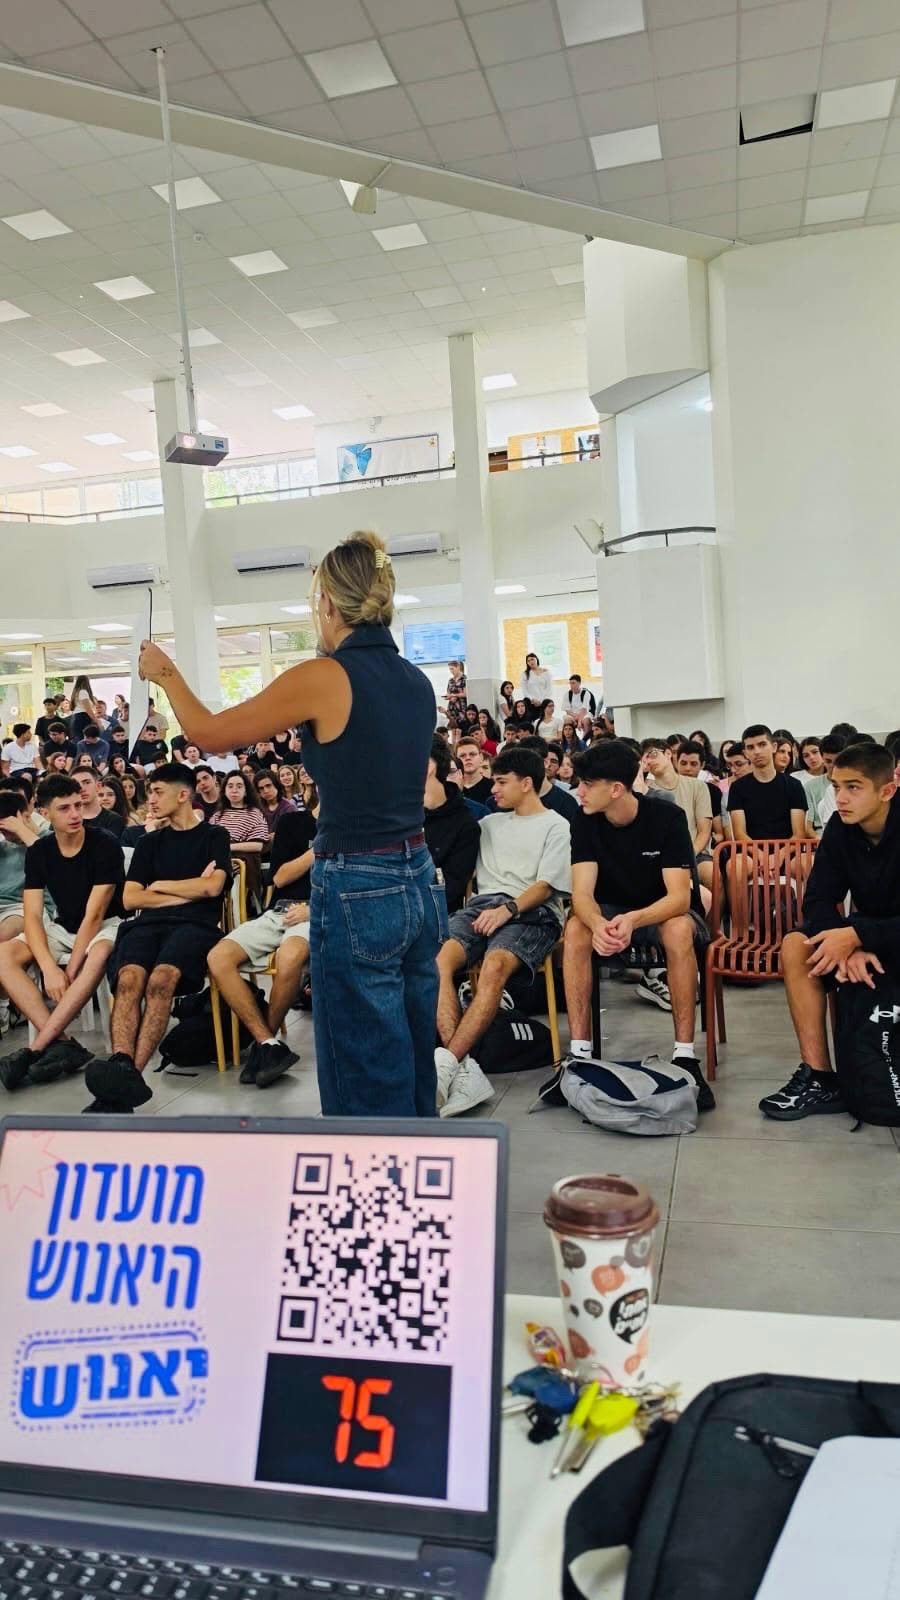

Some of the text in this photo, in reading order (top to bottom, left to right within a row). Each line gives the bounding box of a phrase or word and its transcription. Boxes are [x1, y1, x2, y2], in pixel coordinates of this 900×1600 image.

[47, 1161, 205, 1236] מועדון
[26, 1238, 201, 1310] היאנוש
[20, 1346, 209, 1419] יאנוש
[321, 1374, 395, 1470] 75
